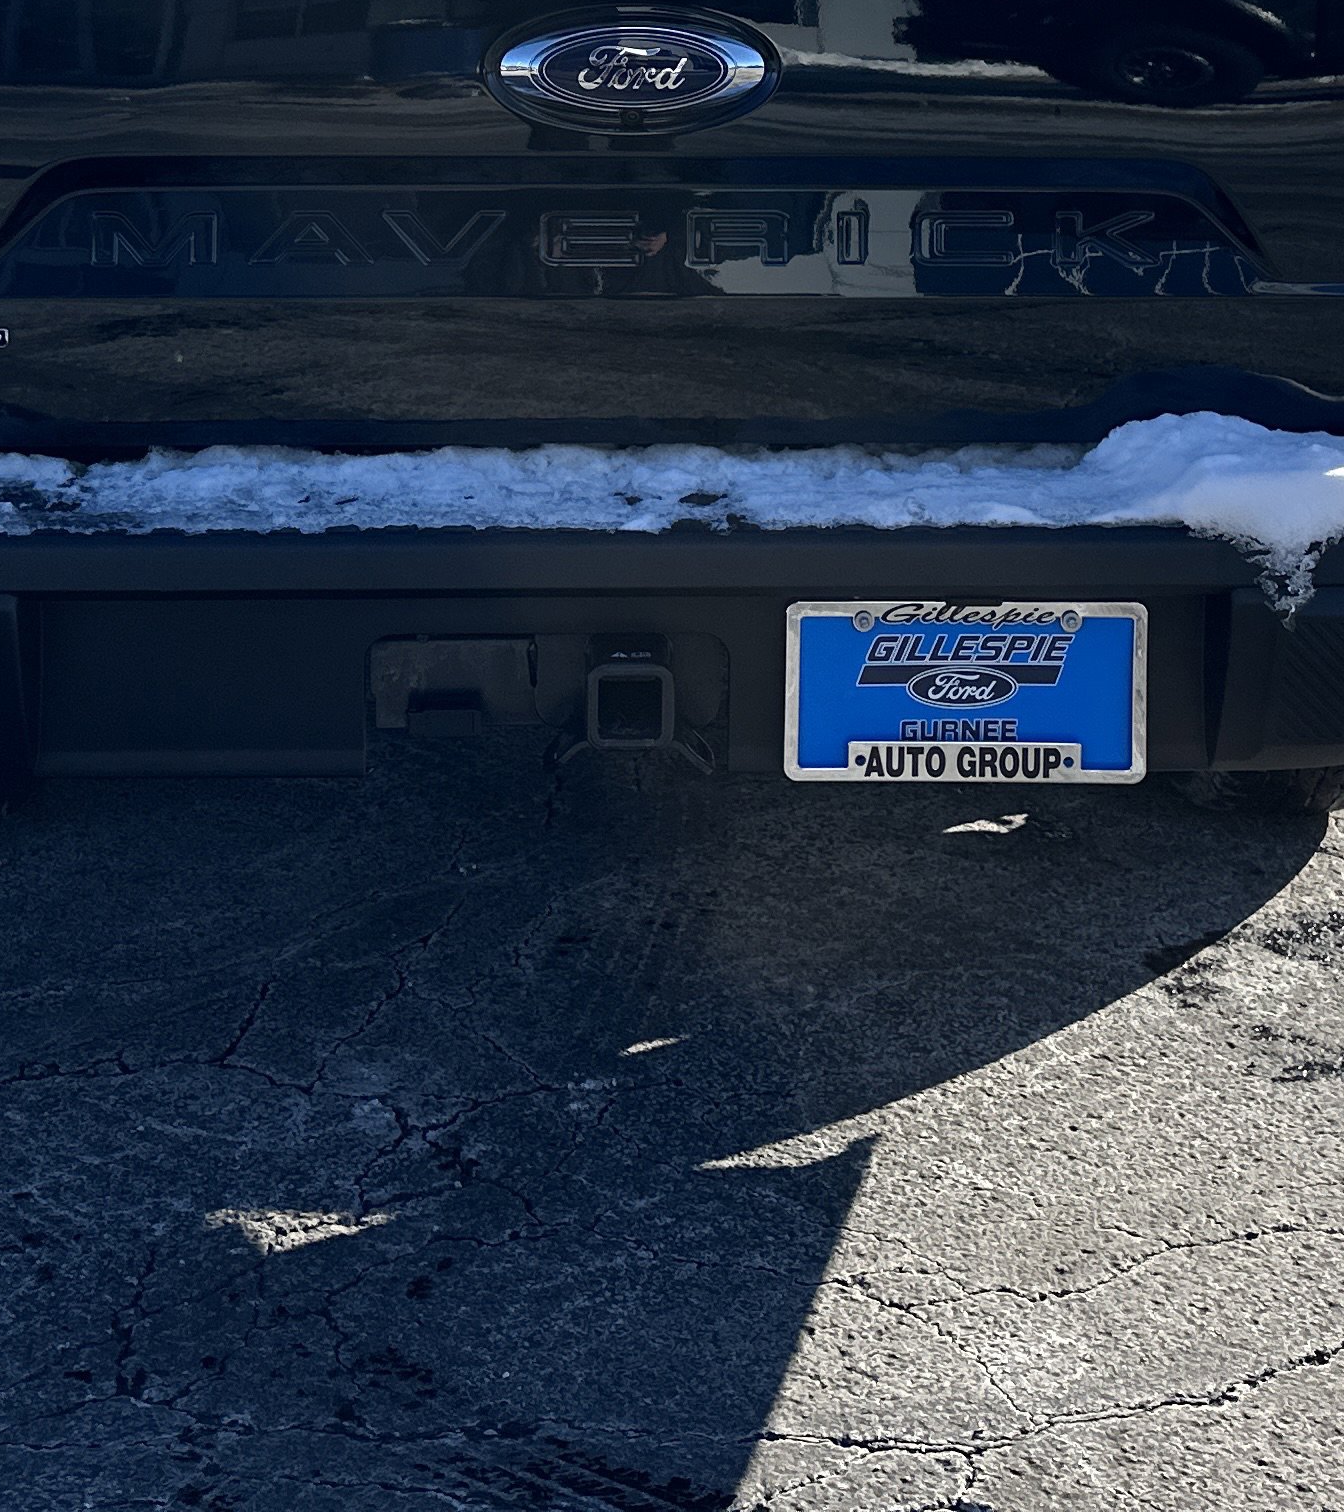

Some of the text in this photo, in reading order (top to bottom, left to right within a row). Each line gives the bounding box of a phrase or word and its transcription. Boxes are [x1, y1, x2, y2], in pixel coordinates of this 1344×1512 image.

[577, 45, 688, 90] Ford
[89, 207, 1166, 269] MAVERICK
[880, 602, 1056, 631] Gillespie
[865, 633, 1076, 664] GILLESPIE
[927, 673, 995, 701] Ford
[899, 718, 1019, 742] GURNEE
[863, 745, 1062, 779] AUTO GROUP
